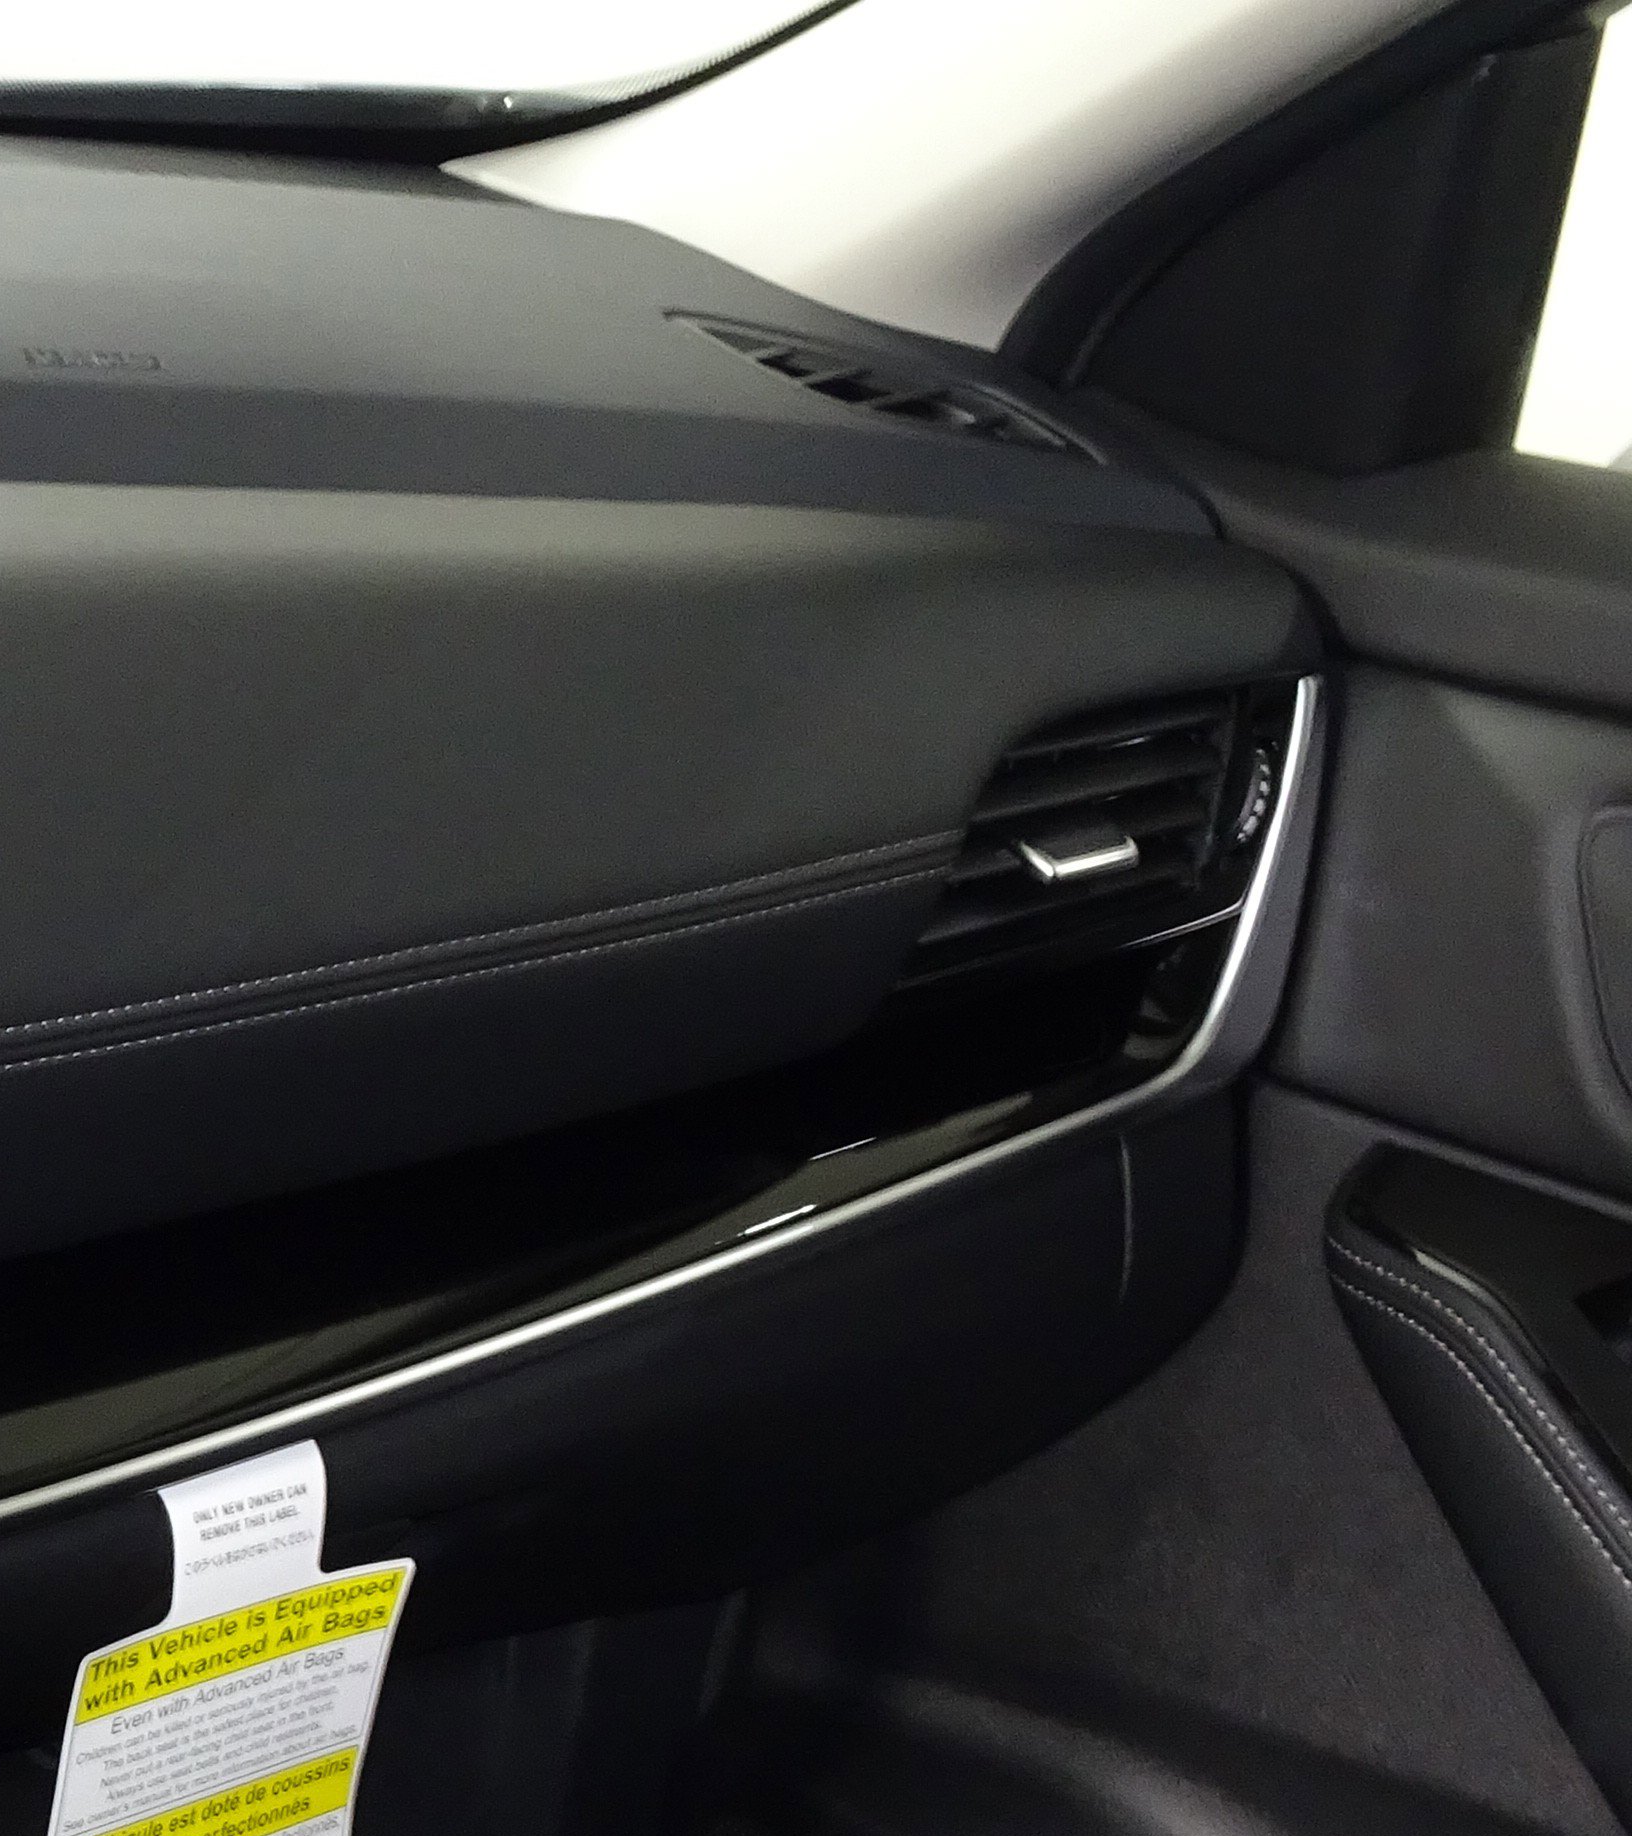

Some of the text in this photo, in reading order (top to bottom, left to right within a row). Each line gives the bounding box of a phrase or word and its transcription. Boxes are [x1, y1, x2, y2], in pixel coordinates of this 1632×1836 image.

[83, 1605, 386, 1712] with Advanced Air Bags
[89, 1573, 398, 1681] This Vehicle is Equipped
[110, 1648, 344, 1735] Even with Advanced Air Bags
[167, 1809, 196, 1832] est
[200, 1793, 240, 1822] doté
[244, 1781, 266, 1805] de
[270, 1754, 351, 1797] coussins
